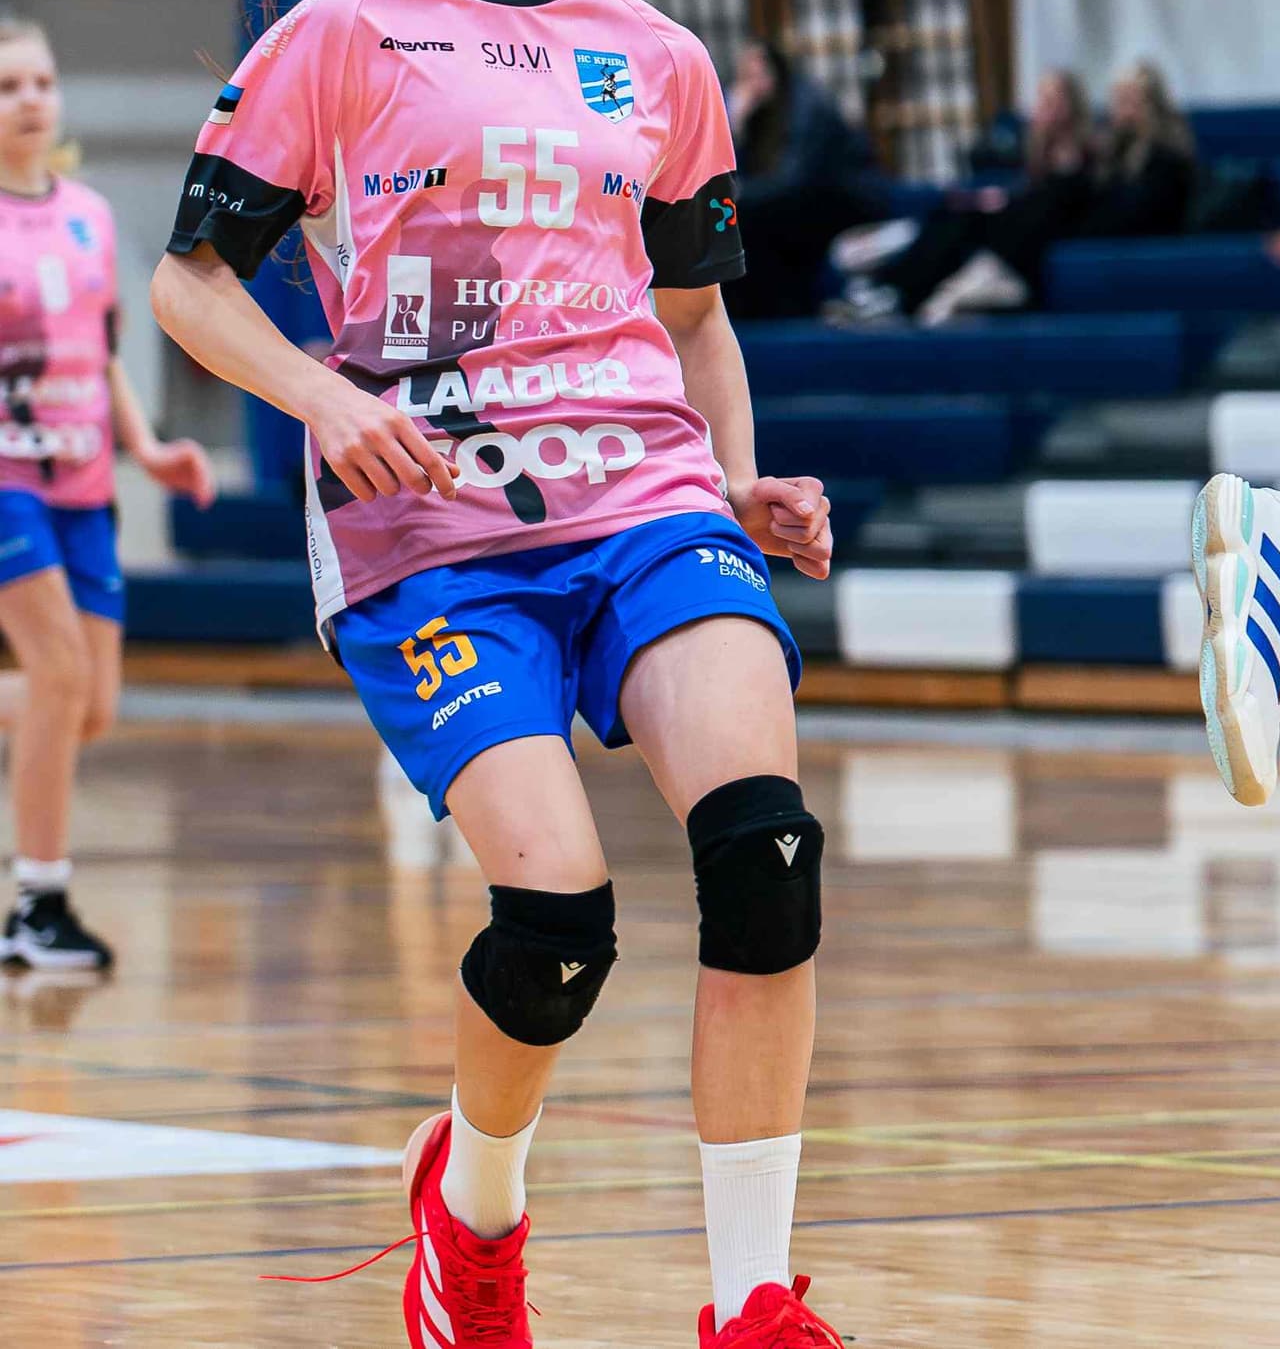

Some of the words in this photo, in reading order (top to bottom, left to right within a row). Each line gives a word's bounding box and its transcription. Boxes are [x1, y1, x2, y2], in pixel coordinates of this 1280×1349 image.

[481, 42, 551, 69] SU.VI
[576, 54, 592, 63] HC
[593, 55, 626, 67] KEHRA
[364, 169, 420, 196] Mobil
[478, 126, 580, 229] 55
[453, 278, 643, 316] HORIZON
[452, 320, 524, 340] PULP
[538, 320, 552, 337] &
[396, 358, 637, 417] LAADUR
[397, 616, 478, 701] 55
